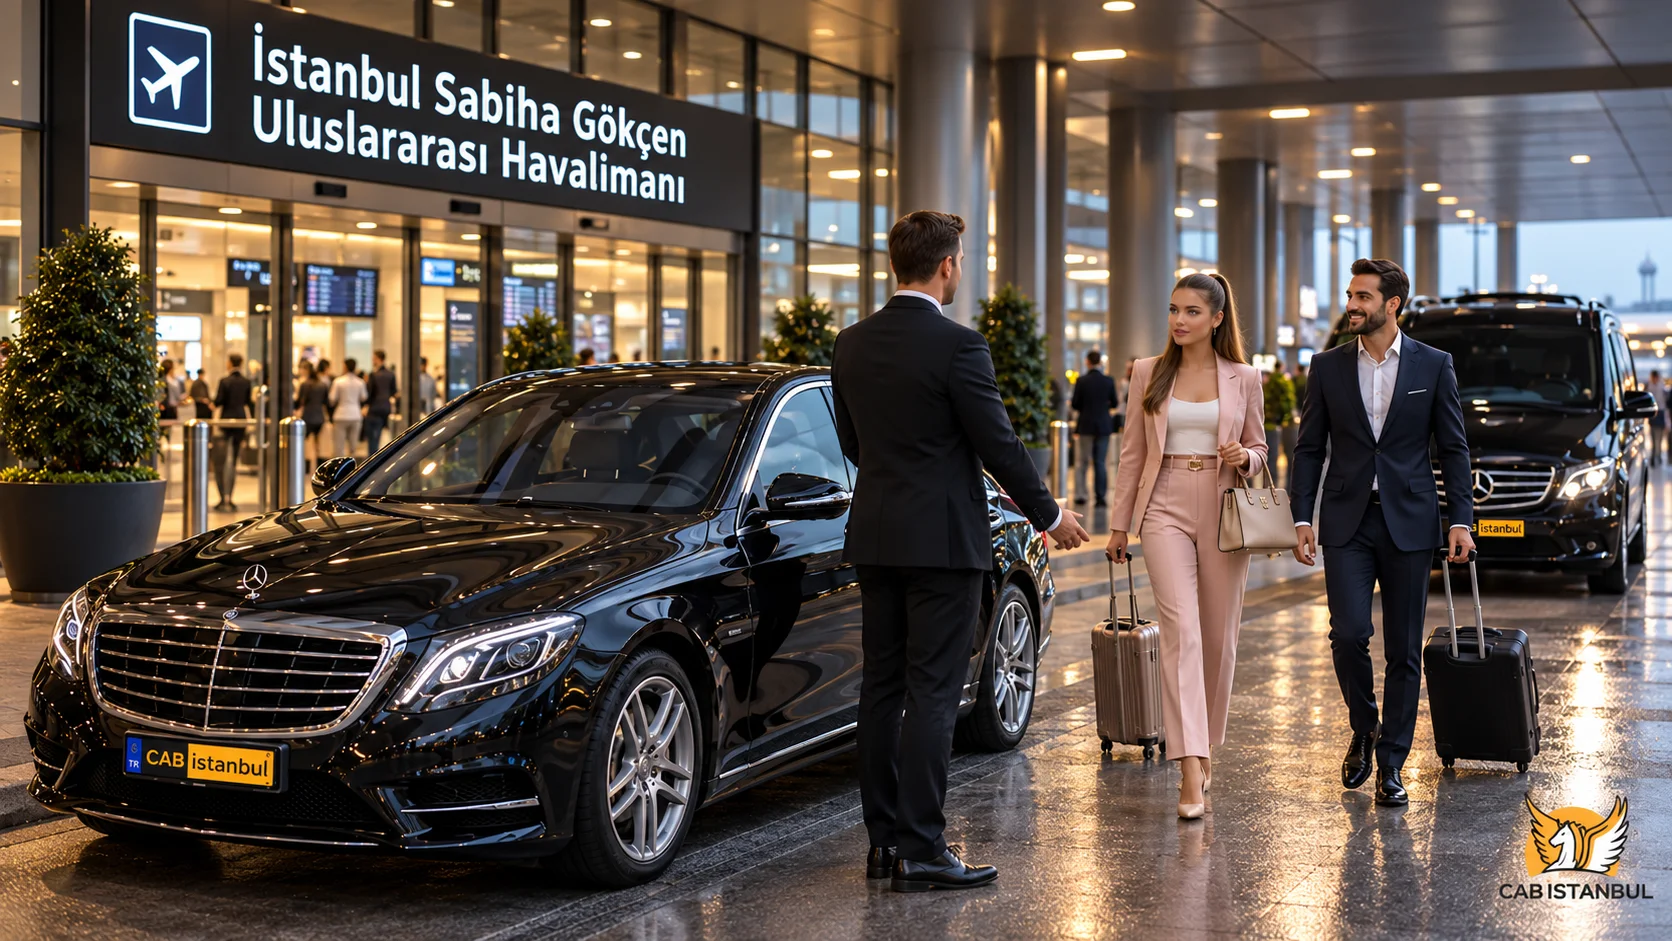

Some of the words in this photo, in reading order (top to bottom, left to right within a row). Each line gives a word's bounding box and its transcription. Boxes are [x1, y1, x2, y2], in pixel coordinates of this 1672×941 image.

[253, 22, 421, 110] İstanbul
[434, 71, 560, 135] Sabiha
[572, 100, 686, 161] Gökçen
[253, 94, 487, 175] Uluslararası
[502, 137, 685, 204] Havalimanı
[1480, 523, 1522, 534] istanbul
[128, 759, 140, 769] TR
[146, 749, 185, 768] CAB
[191, 753, 268, 777] istanbul
